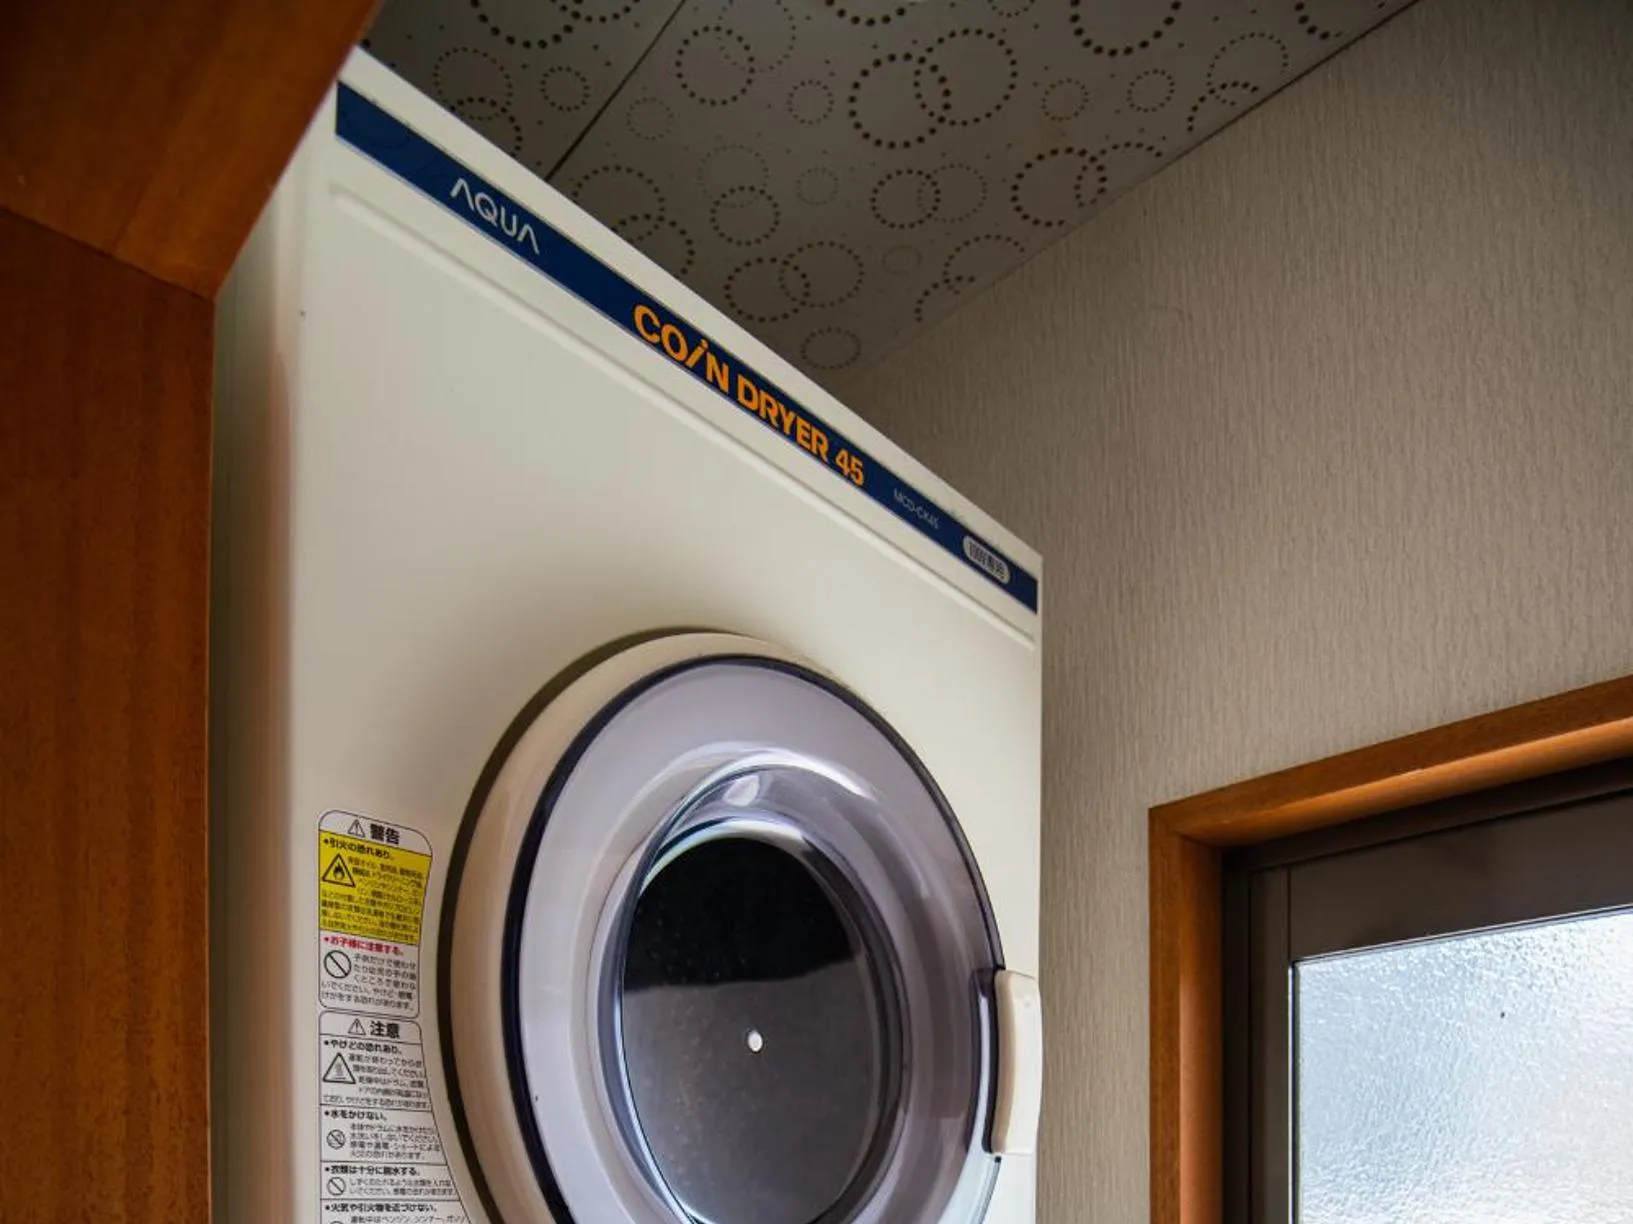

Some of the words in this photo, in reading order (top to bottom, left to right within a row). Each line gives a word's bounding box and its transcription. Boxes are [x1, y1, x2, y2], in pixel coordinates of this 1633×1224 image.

[450, 177, 540, 255] AQUA
[634, 303, 730, 393] COIN
[737, 376, 830, 461] DRYER
[835, 447, 865, 486] 45
[370, 1020, 400, 1039] 注意
